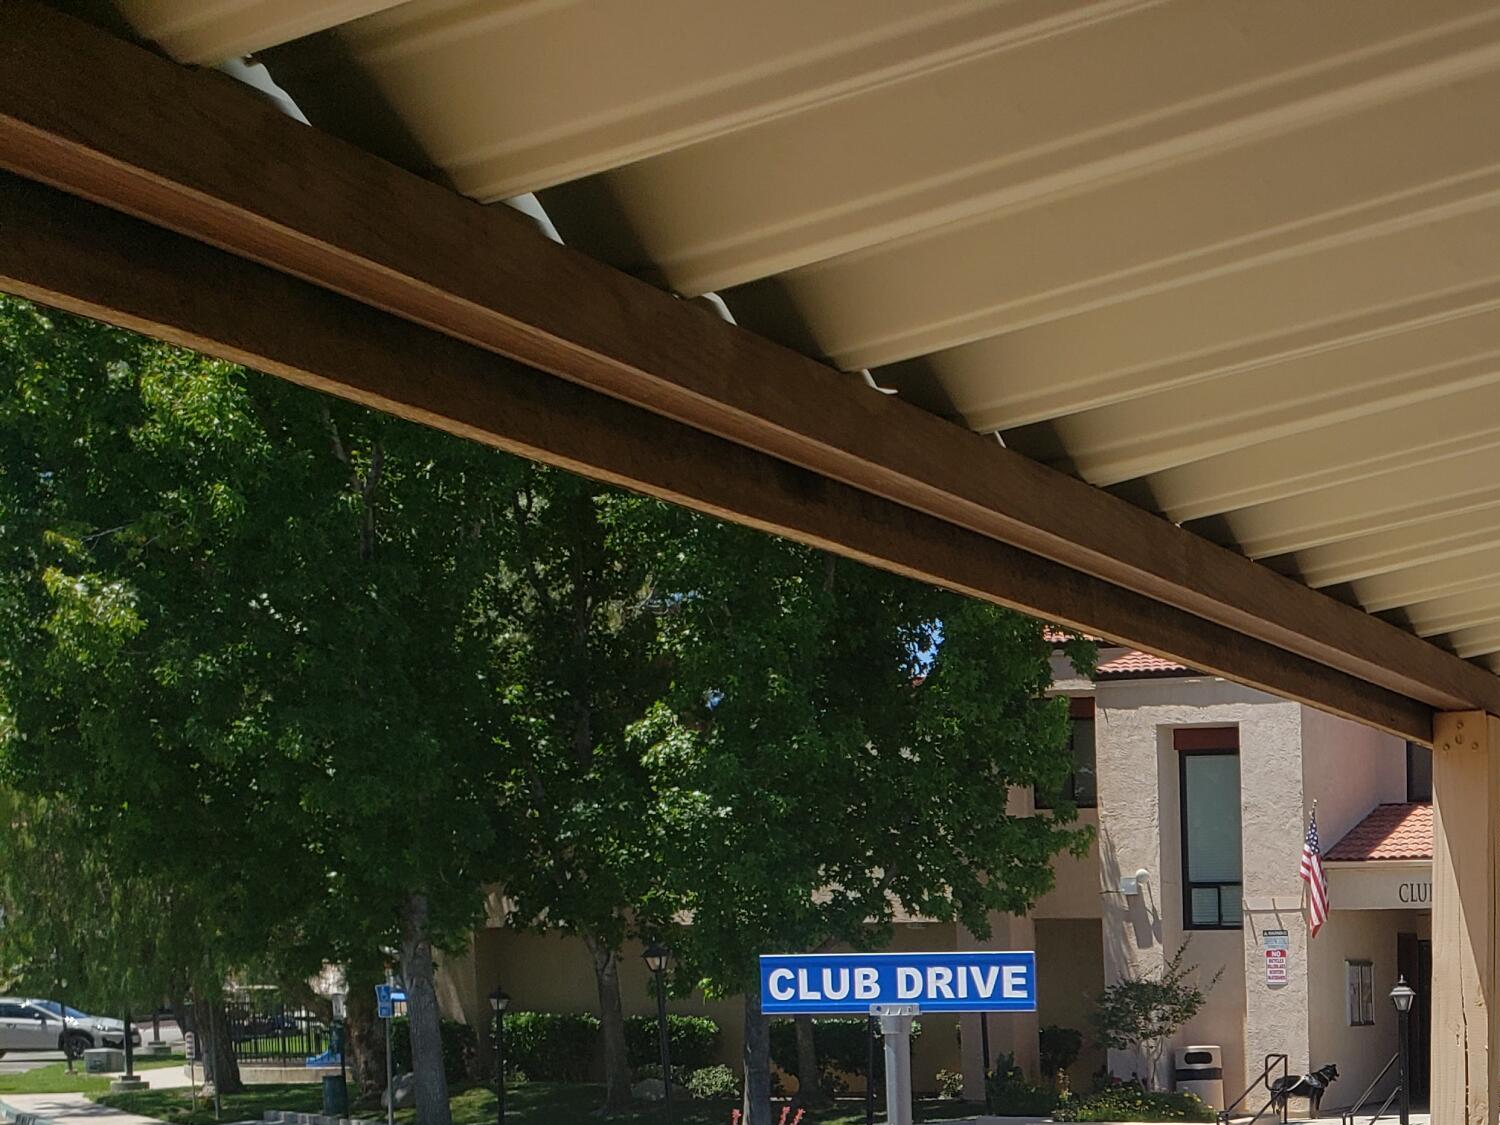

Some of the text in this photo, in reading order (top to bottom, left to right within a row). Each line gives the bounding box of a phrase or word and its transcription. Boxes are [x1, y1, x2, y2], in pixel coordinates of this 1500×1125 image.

[1399, 883, 1432, 903] CLU
[768, 965, 1028, 1000] CLUB DRIVE
